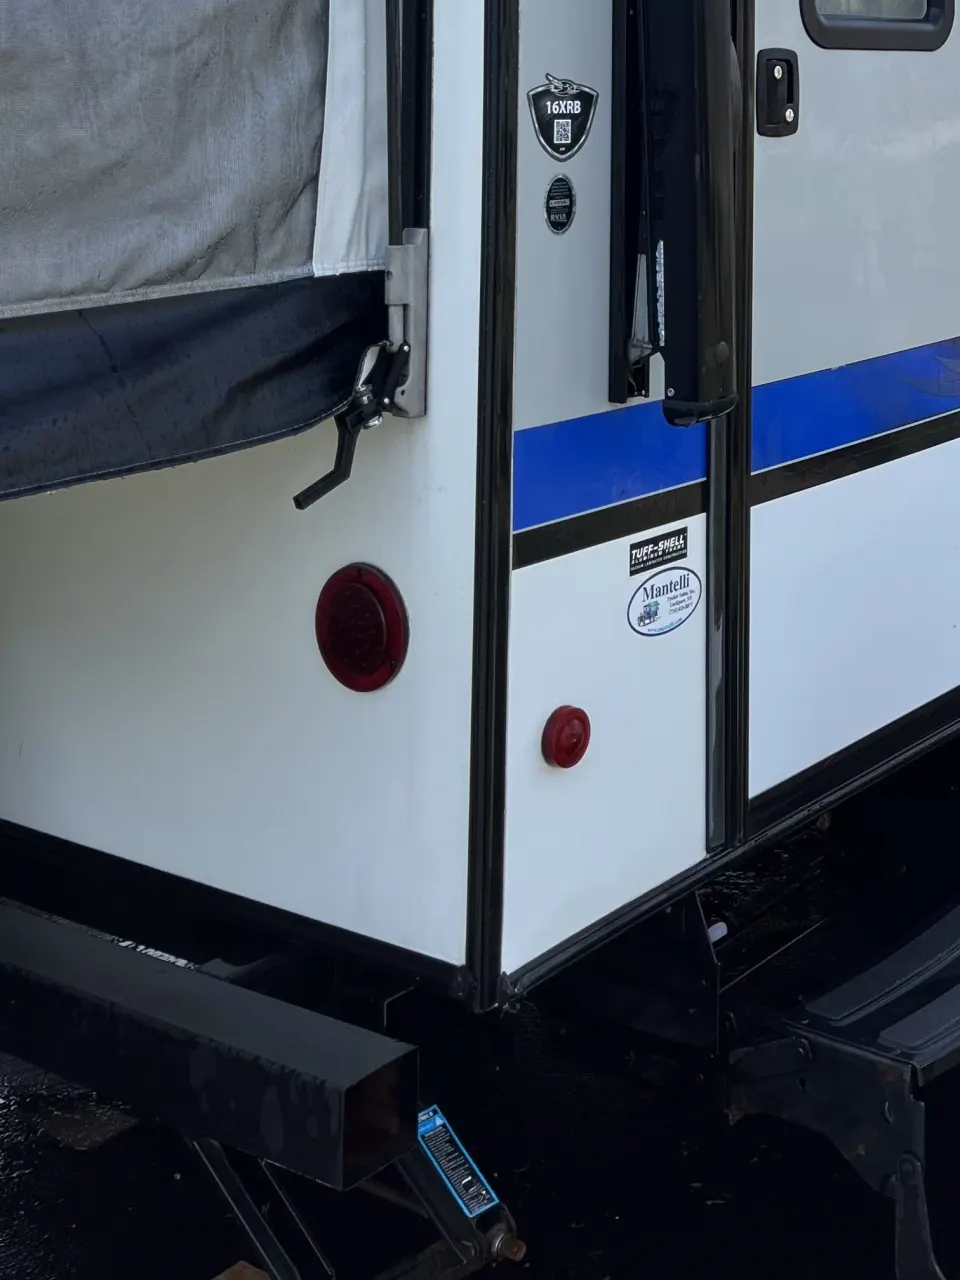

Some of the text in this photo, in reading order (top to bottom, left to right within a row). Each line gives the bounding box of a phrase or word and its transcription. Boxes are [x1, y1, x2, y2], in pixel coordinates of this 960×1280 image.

[546, 100, 582, 115] 16XRB
[631, 534, 685, 560] TUFF-SHELL
[642, 573, 690, 602] Mantelli
